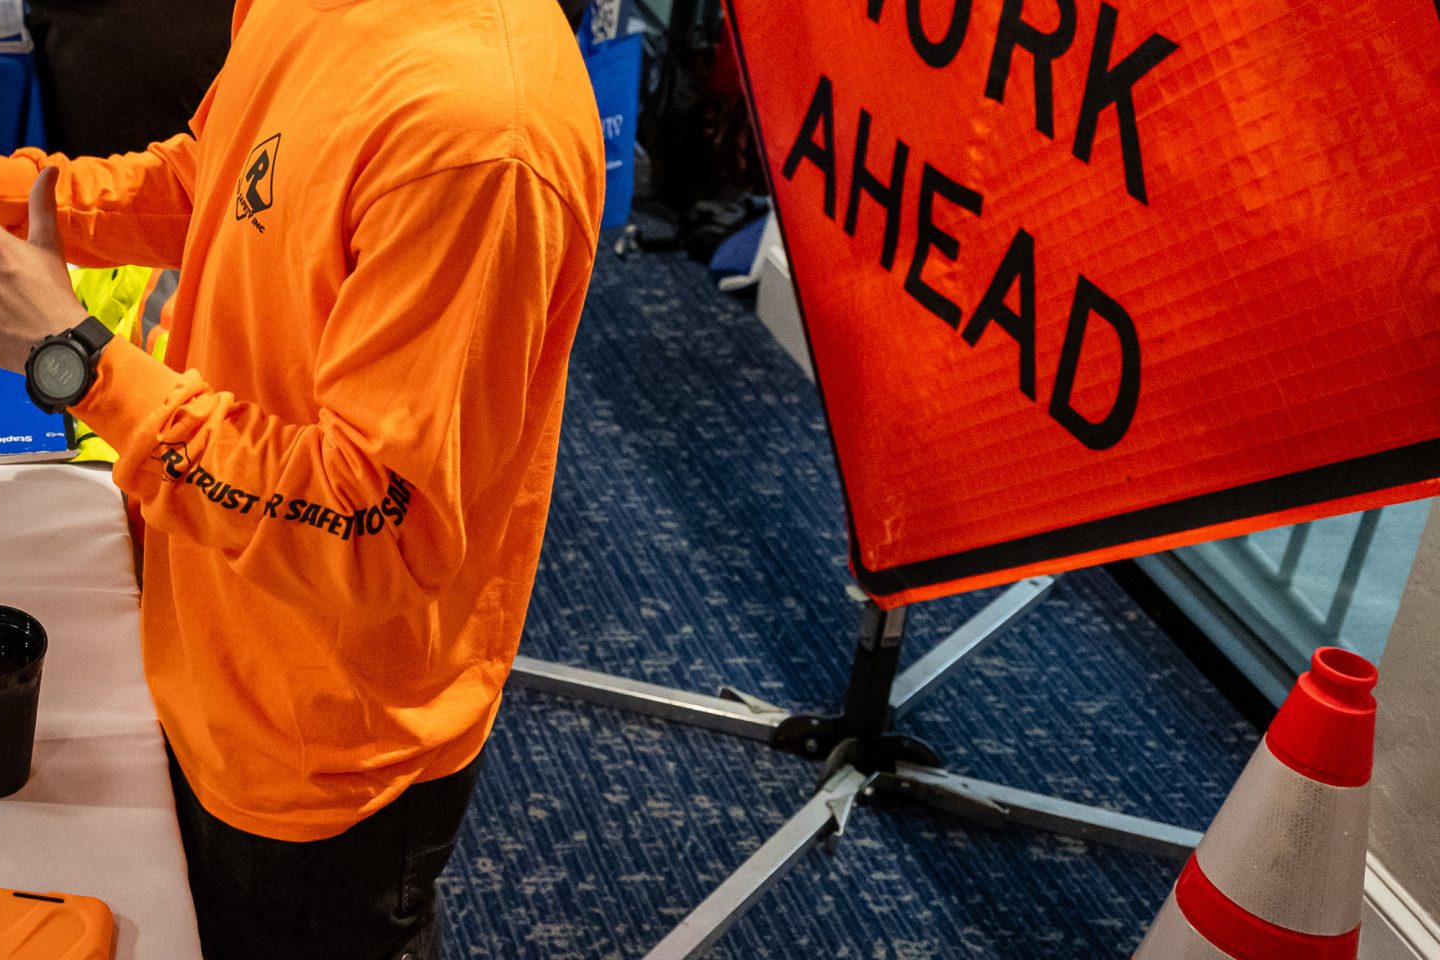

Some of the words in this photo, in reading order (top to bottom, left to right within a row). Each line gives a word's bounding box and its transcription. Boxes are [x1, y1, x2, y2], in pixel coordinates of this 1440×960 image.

[252, 217, 266, 234] INC
[782, 74, 1141, 451] AHEAD
[184, 465, 260, 515] TRUST
[354, 506, 386, 536] TO
